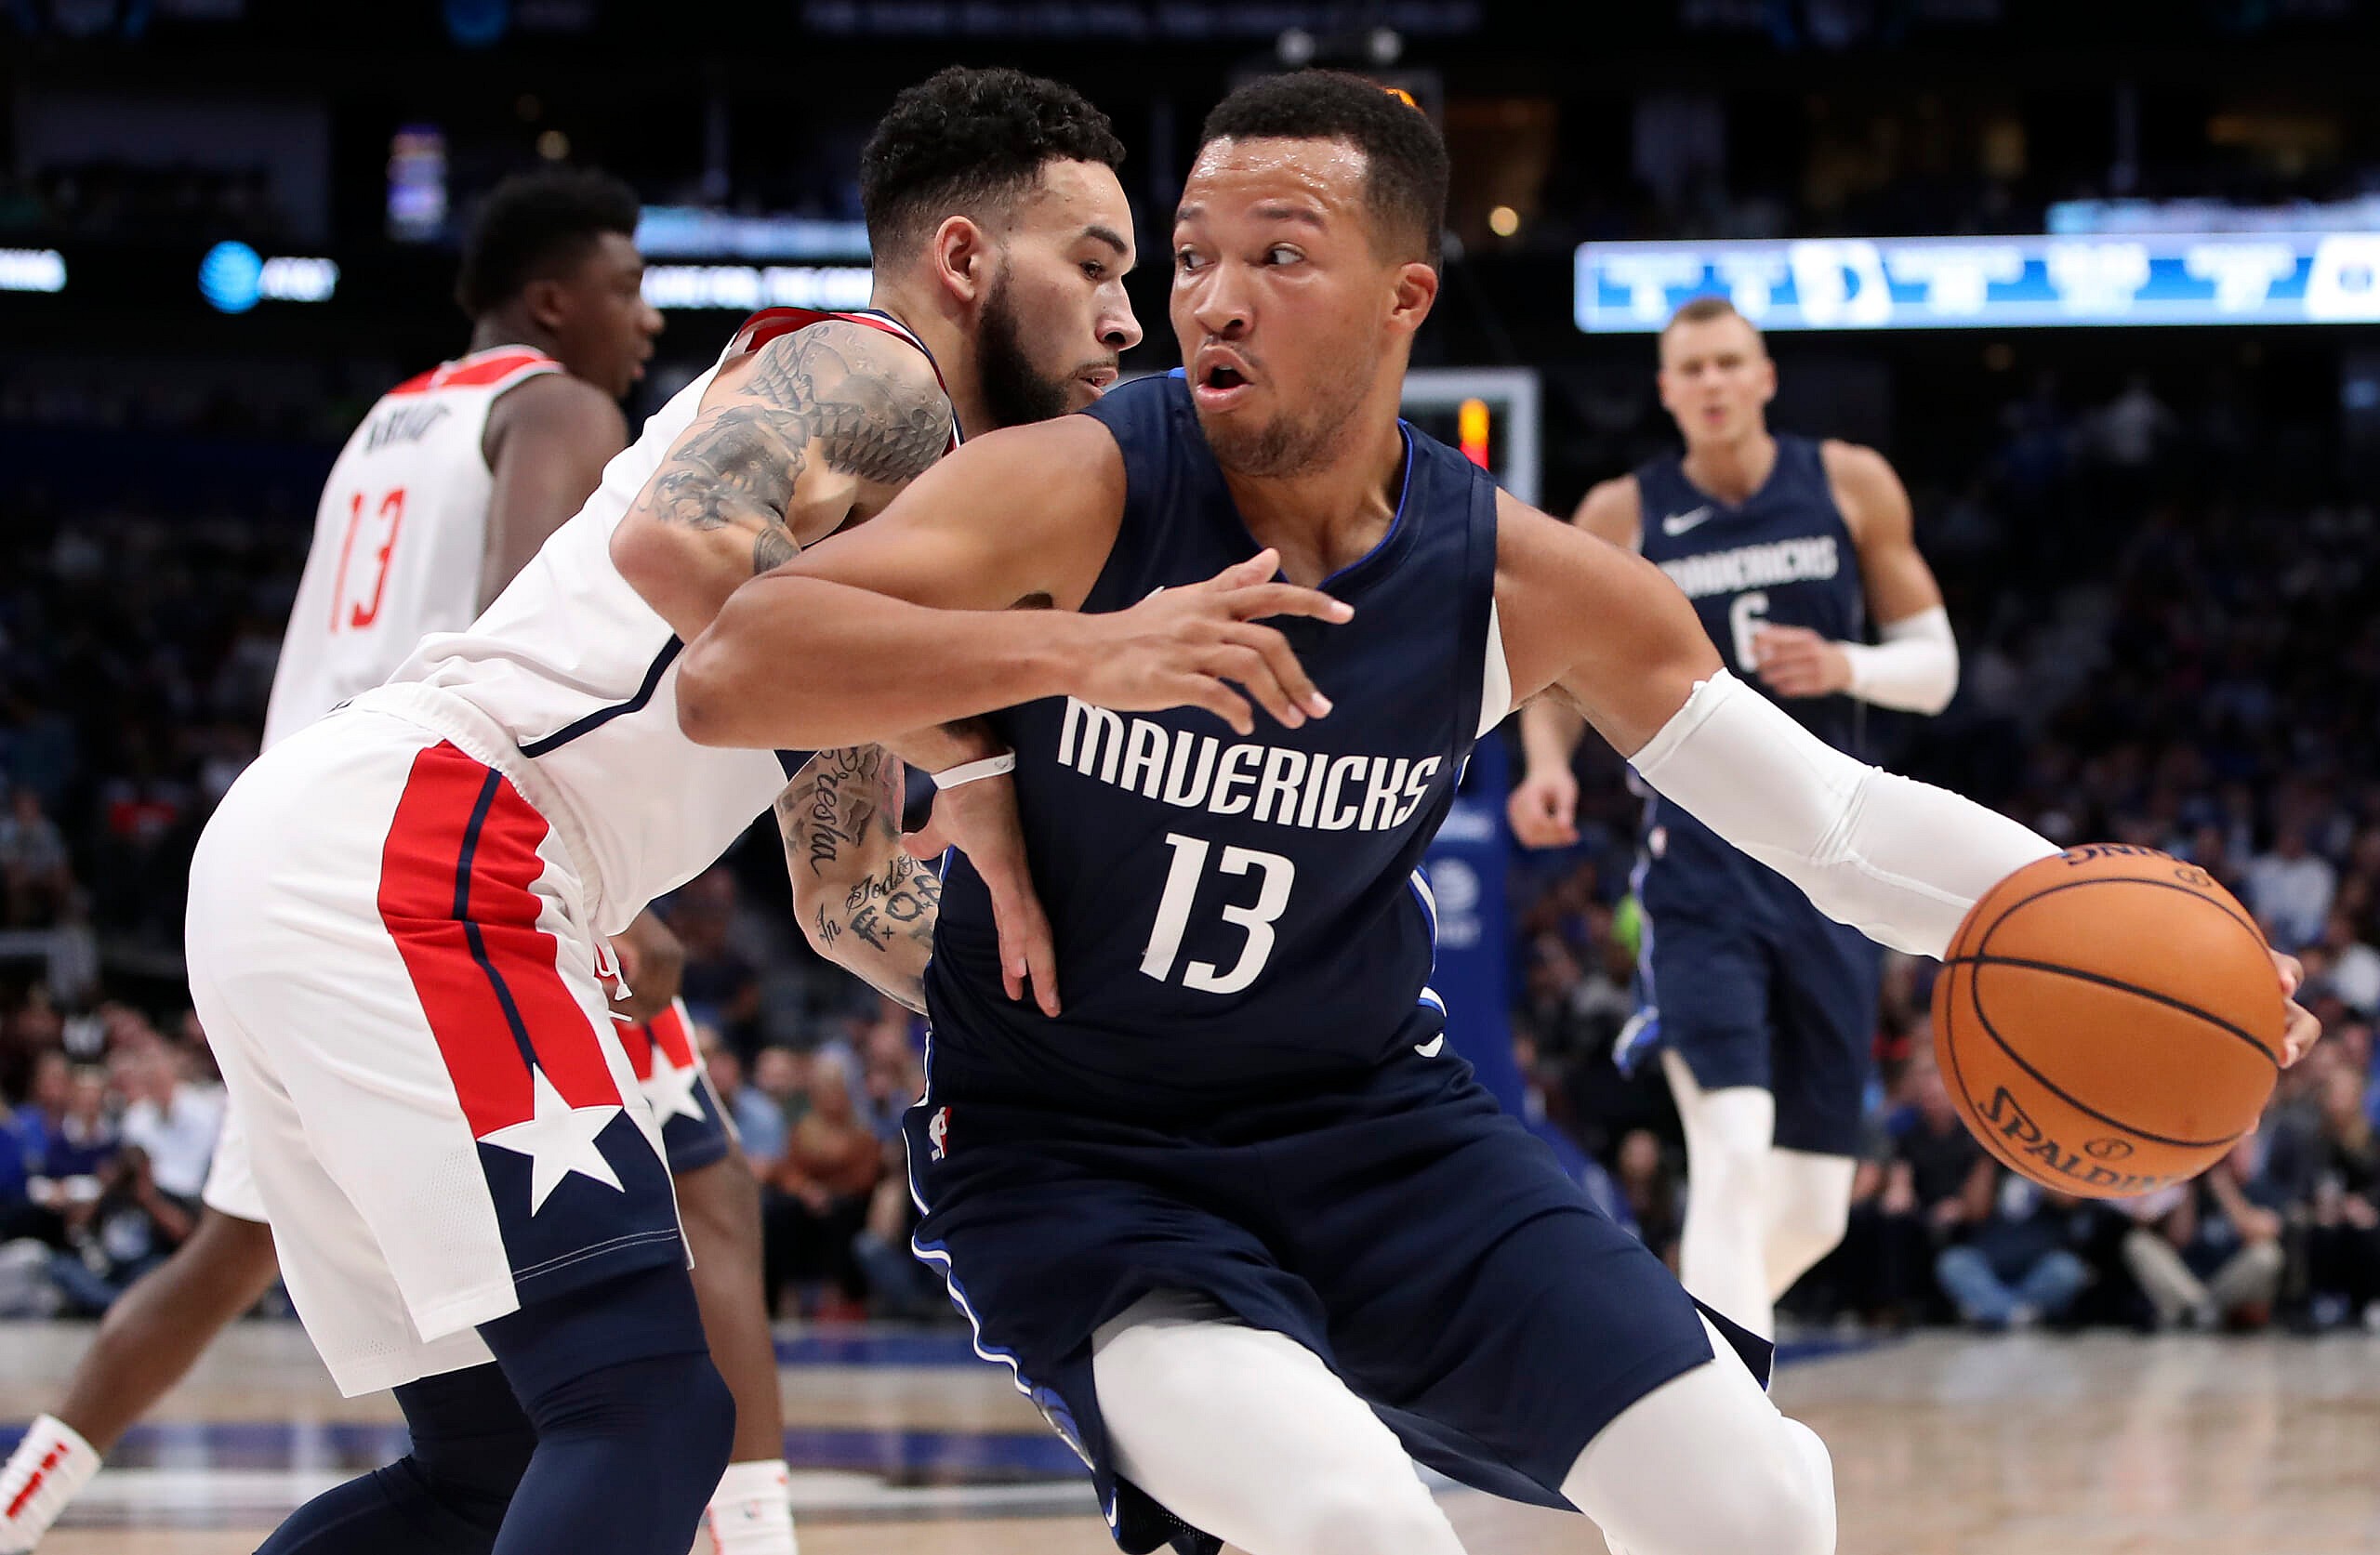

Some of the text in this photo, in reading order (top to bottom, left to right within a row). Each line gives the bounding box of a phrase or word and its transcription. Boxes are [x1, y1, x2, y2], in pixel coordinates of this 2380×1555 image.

[330, 487, 407, 635] 13
[1057, 695, 1442, 832] MAVERICKS
[1139, 832, 1295, 995] 13
[1978, 1086, 2175, 1193] SPALDI
